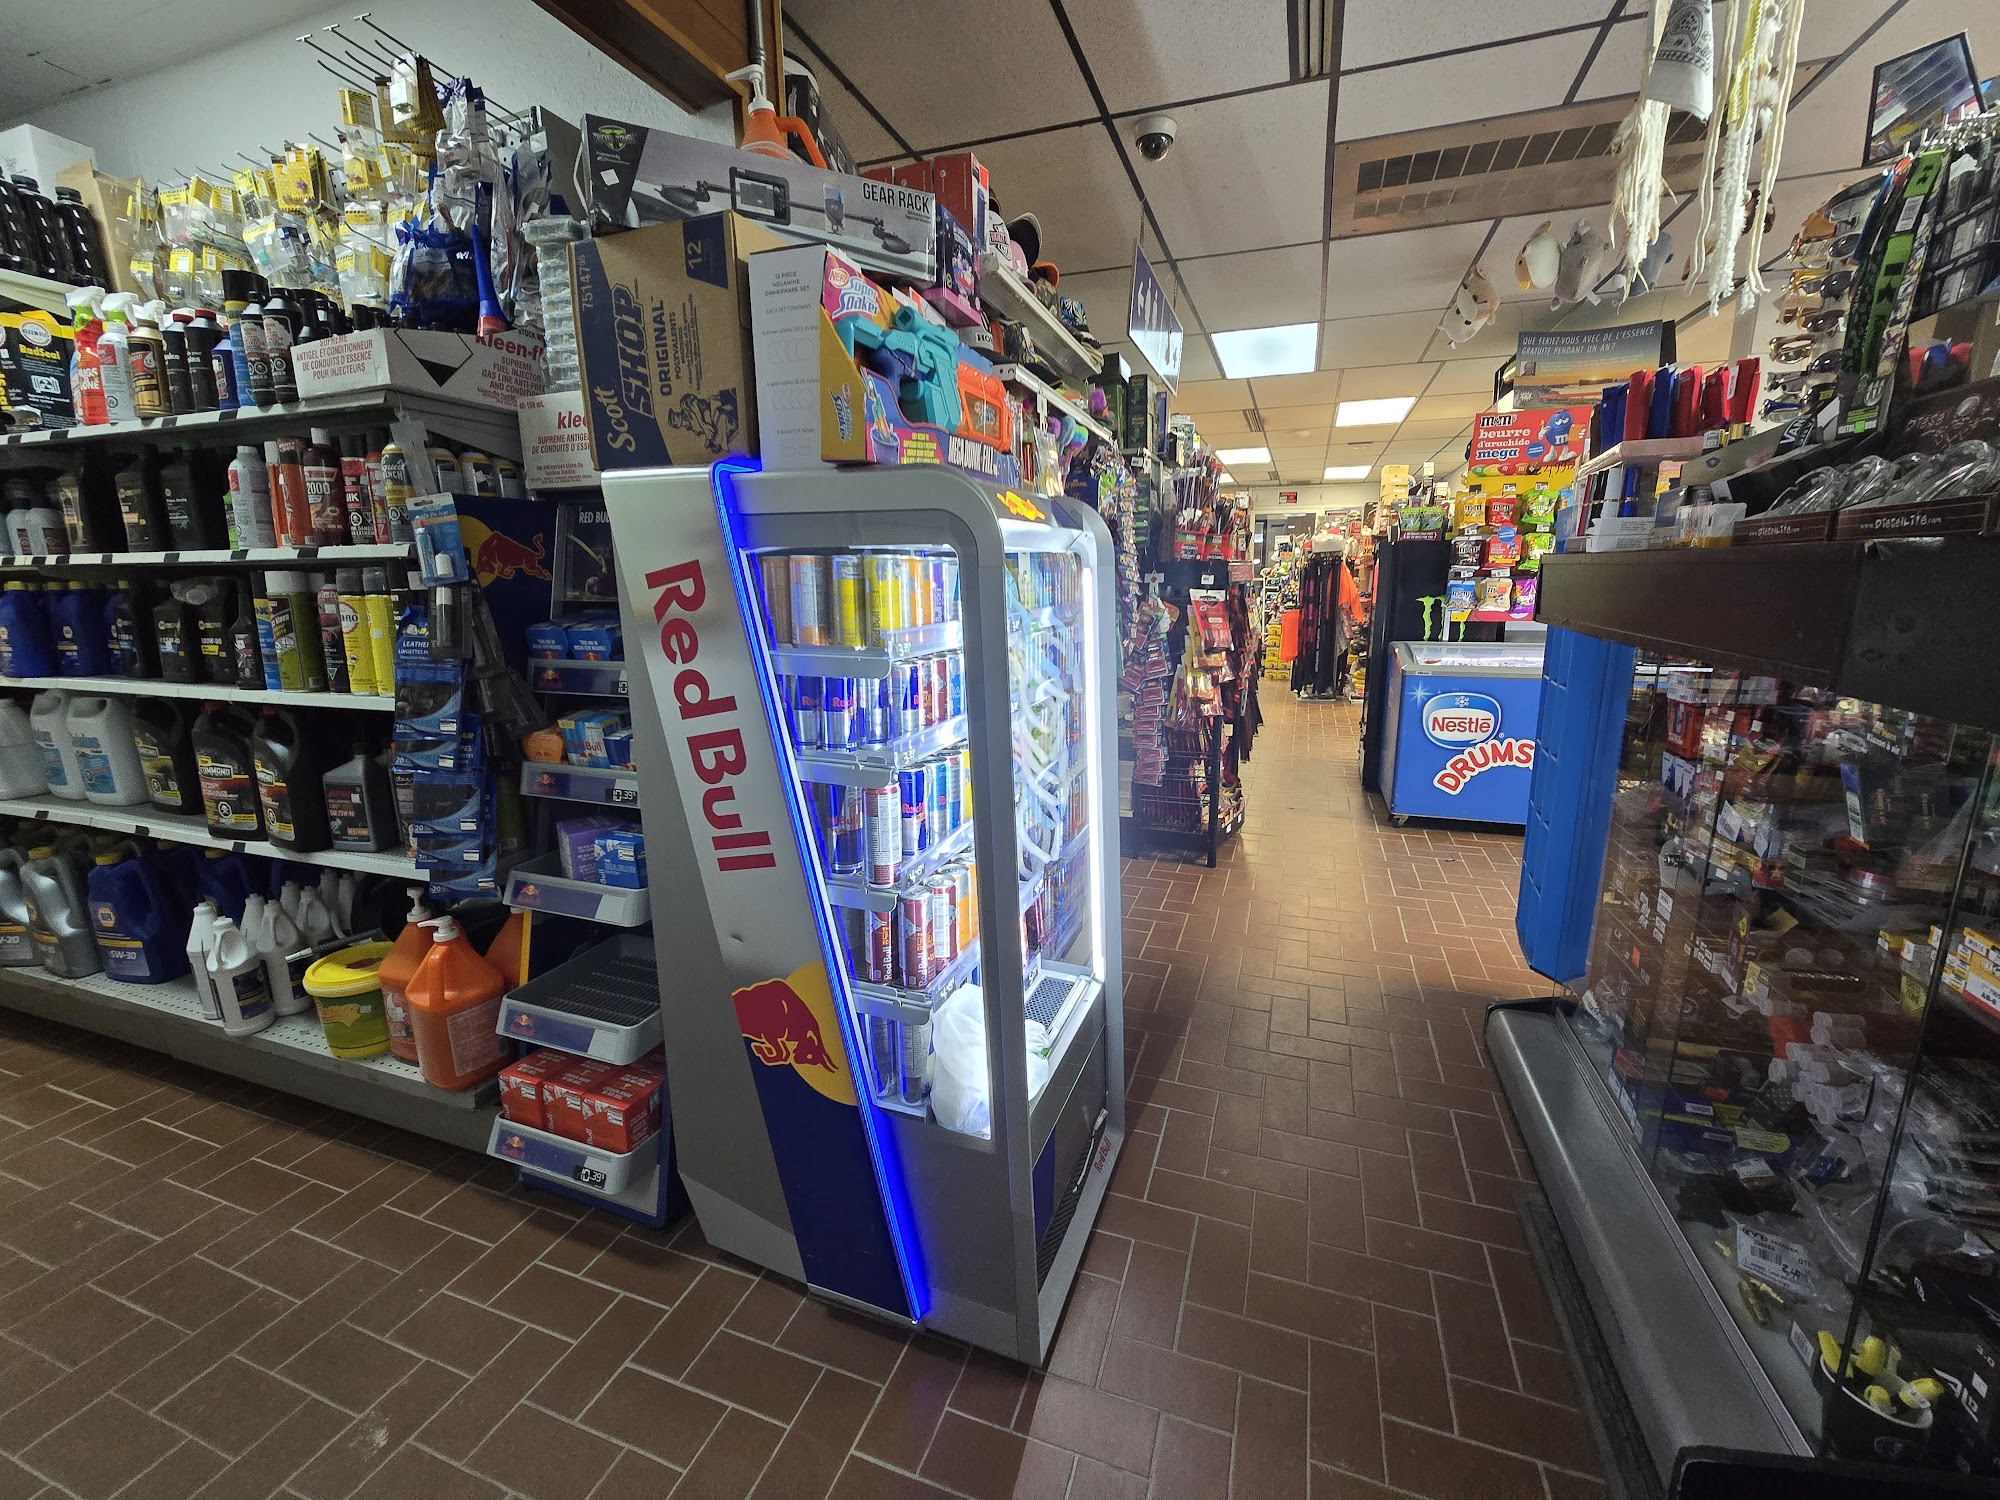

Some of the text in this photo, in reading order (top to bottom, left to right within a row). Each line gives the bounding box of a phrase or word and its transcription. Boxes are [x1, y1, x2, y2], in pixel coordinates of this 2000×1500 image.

[862, 182, 930, 214] GEAR RACK
[687, 240, 702, 270] 12
[830, 270, 849, 284] NERF
[849, 277, 877, 300] Super
[832, 292, 878, 317] Soaker
[1522, 325, 1656, 345] QUE FERIEZ-VOUS AVEC DE L'ESSENCE
[18, 343, 61, 360] RadSeal
[296, 339, 373, 362] ANTIGEL ET CONDITIONNEUR
[612, 283, 653, 418] SHOP
[651, 300, 672, 396] ORIGINAL
[669, 311, 681, 380] POLYVALENTS
[1521, 342, 1617, 355] GRATUITE PENDANT UN AN?
[302, 351, 372, 371] DE CONDUITS D'ESSENCE
[493, 362, 510, 375] FUEL
[501, 356, 532, 372] SUPREME
[312, 362, 366, 380] POUR INJECTEURS
[482, 368, 496, 380] GAS
[498, 373, 513, 385] LINE
[489, 380, 505, 391] AND
[593, 385, 636, 452] Scott
[537, 433, 588, 445] SUPREME ANTIGE
[1478, 428, 1531, 440] beurre
[531, 445, 540, 455] DE
[540, 444, 570, 454] CONDUITS
[1477, 438, 1531, 448] d'arachide
[949, 435, 965, 469] MEGA
[1475, 447, 1520, 461] mega
[307, 481, 331, 495] 2000
[578, 511, 611, 524] RED BUL
[645, 559, 777, 872] Red Bull
[585, 740, 602, 751] Bull
[1437, 741, 1535, 792] DRUMS
[109, 951, 137, 961] 5W-30
[883, 947, 893, 965] Bull
[884, 964, 893, 981] Red
[1094, 1135, 1113, 1174] Red Bull
